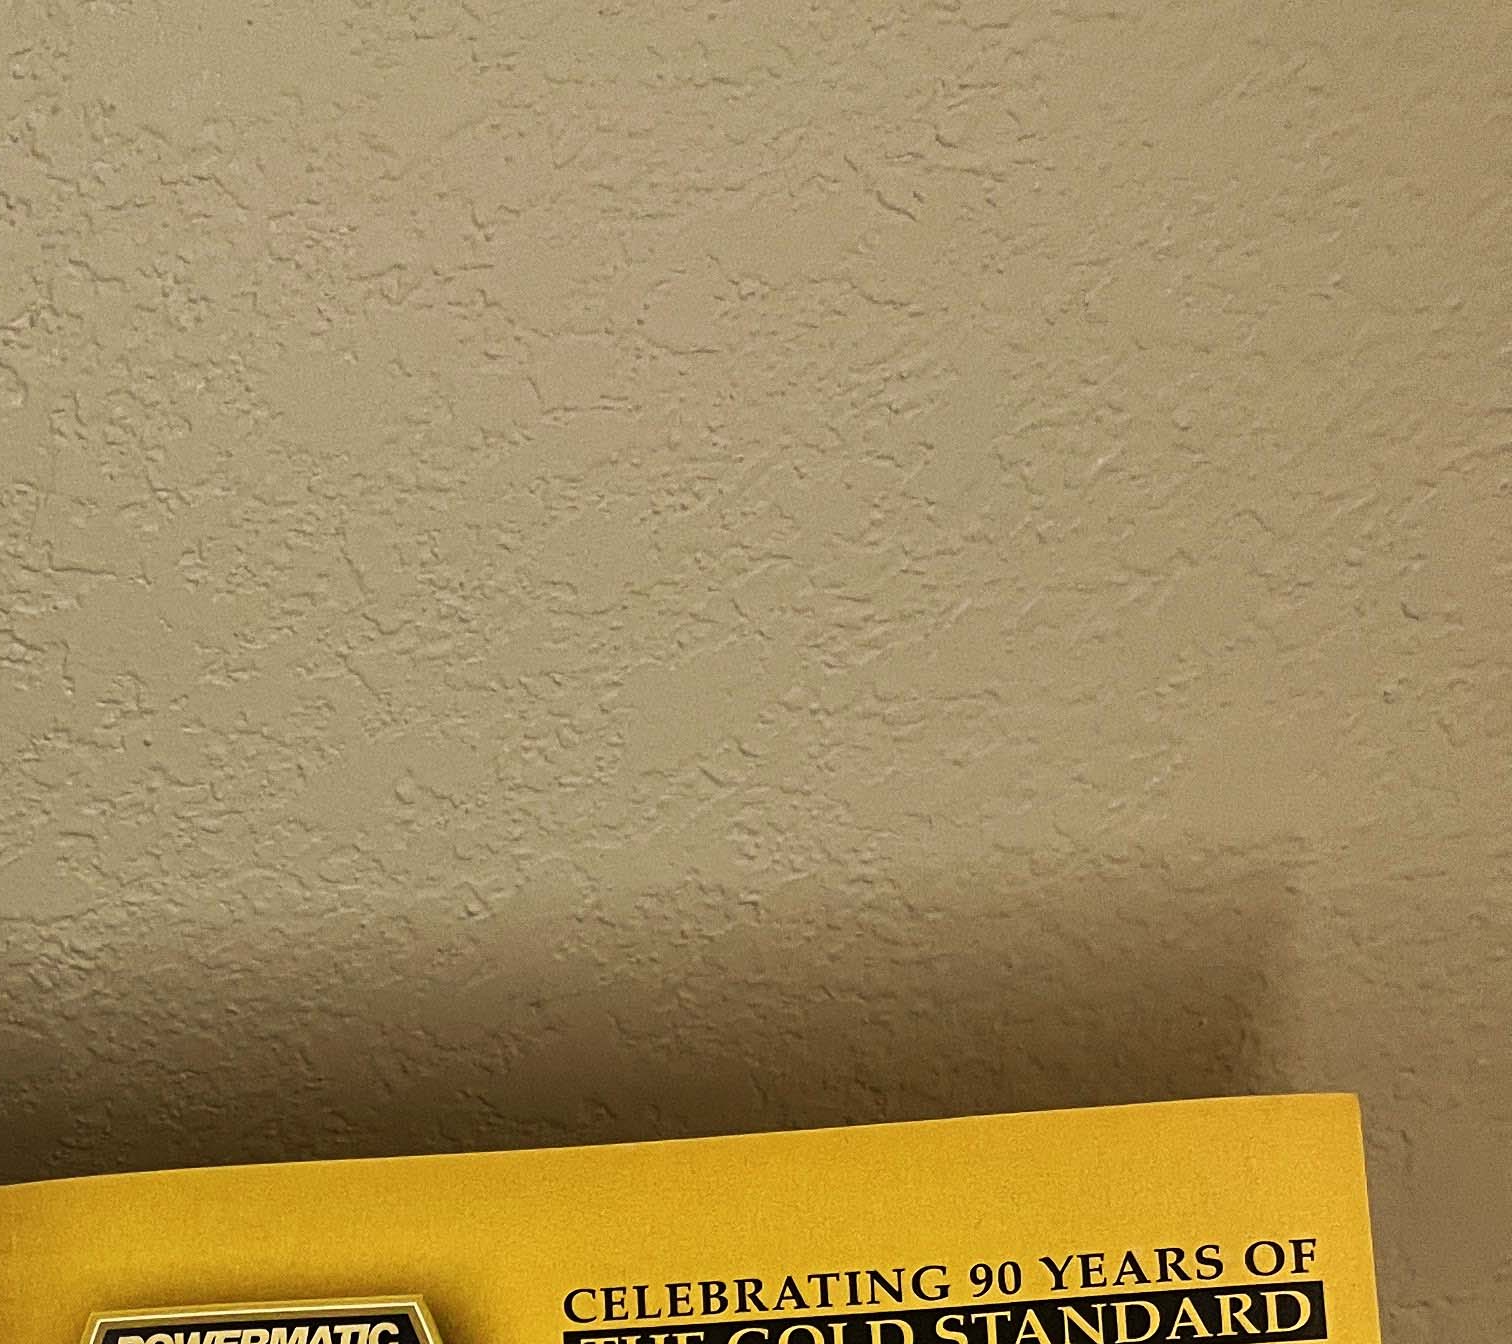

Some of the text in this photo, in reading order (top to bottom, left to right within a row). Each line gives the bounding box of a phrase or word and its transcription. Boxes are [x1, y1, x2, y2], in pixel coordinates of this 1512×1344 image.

[563, 1237, 1317, 1324] CELEBRATING 90 YEARS OF
